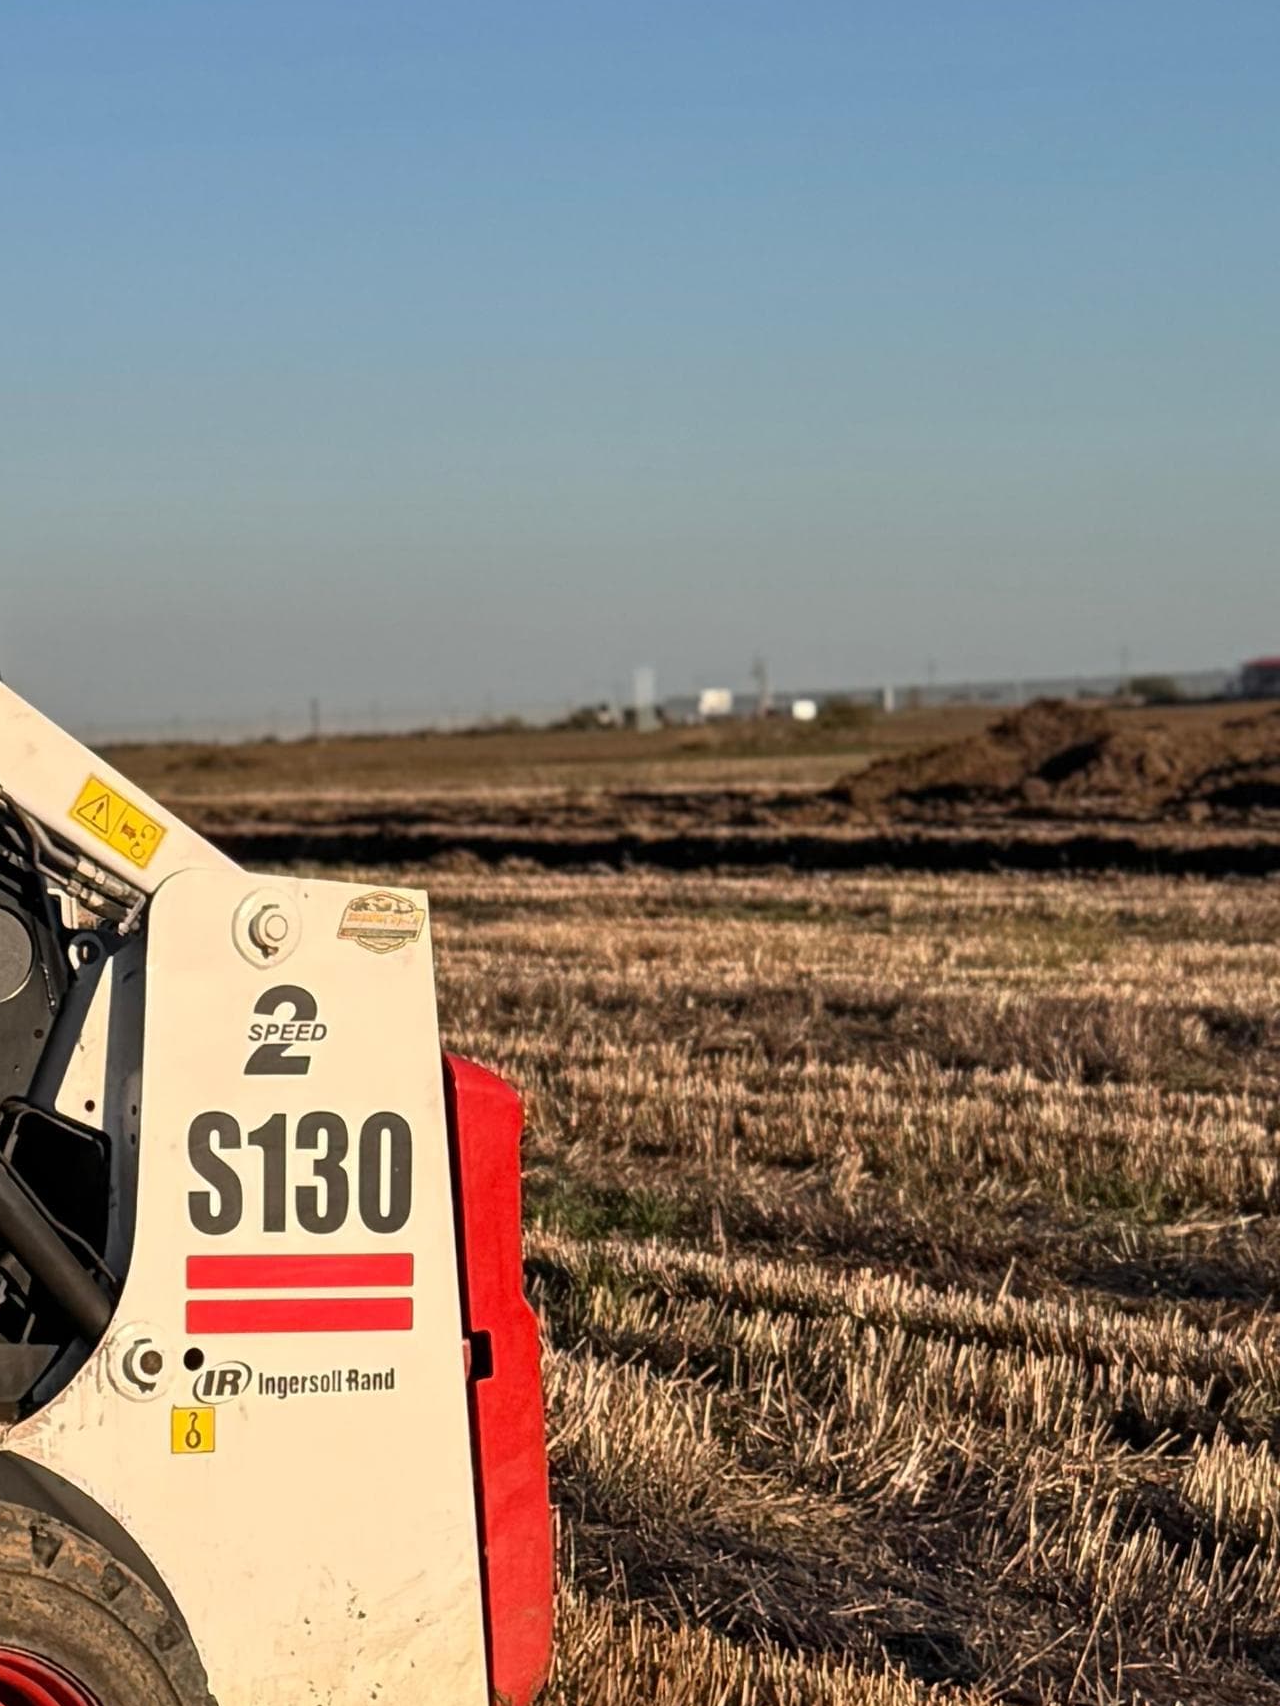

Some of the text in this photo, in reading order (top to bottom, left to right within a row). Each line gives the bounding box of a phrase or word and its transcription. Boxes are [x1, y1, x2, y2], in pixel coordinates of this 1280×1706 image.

[243, 984, 318, 1075] 2
[247, 1023, 328, 1041] SPEED
[186, 1110, 413, 1236] S130
[202, 1369, 243, 1396] IR
[258, 1367, 395, 1399] Ingersoll Rand
